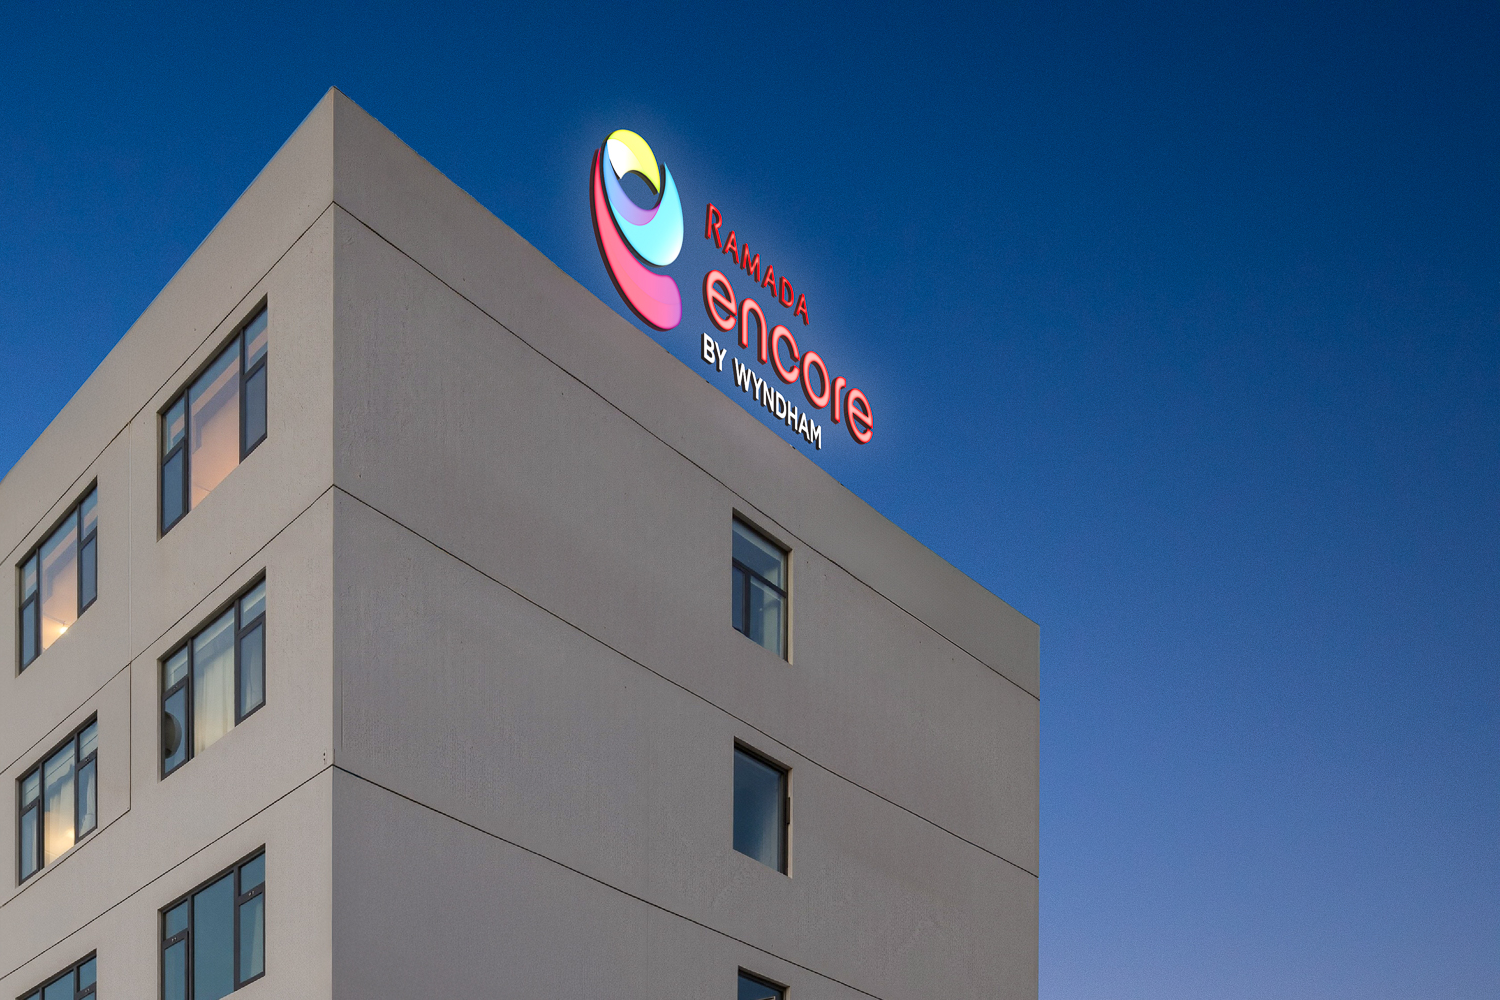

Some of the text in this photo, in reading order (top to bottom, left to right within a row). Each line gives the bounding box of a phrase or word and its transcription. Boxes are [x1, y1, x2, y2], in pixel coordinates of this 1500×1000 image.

[705, 203, 809, 325] RAMADA
[701, 333, 821, 449] BY WYNDHAM
[703, 270, 873, 444] encore
